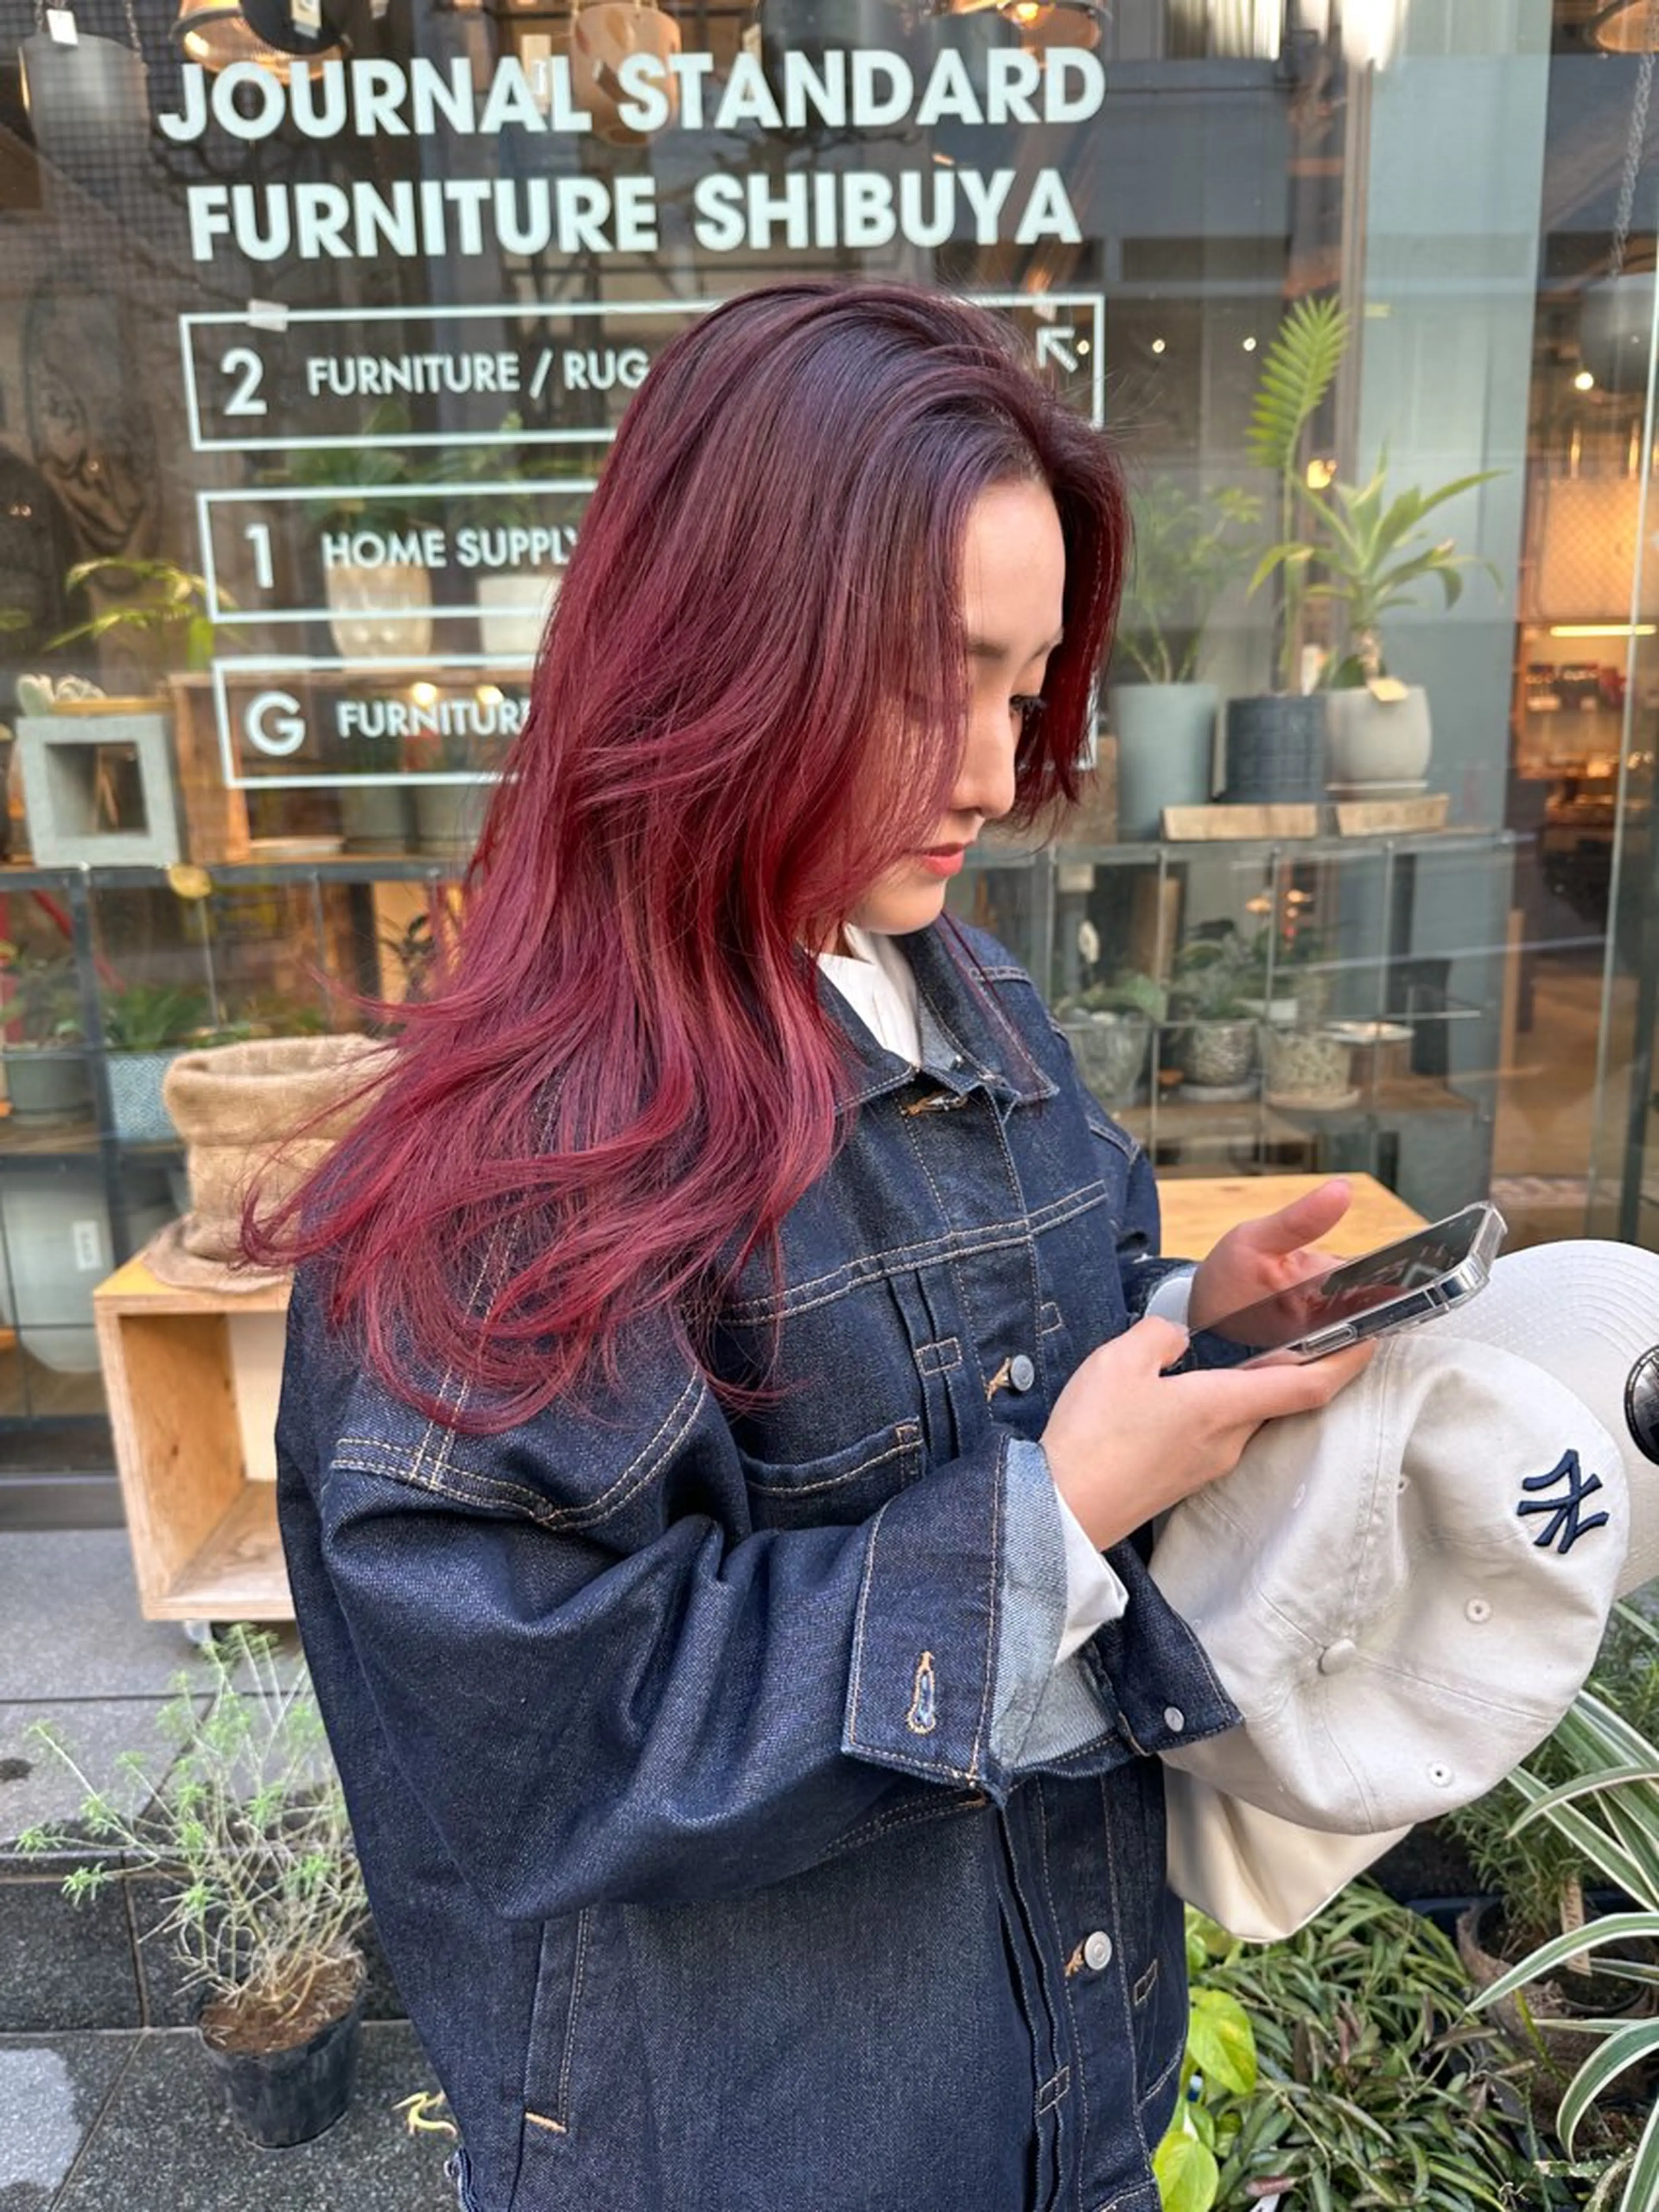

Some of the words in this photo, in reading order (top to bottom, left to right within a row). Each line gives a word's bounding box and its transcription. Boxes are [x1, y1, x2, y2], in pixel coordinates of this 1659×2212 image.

[158, 56, 592, 141] JOURNAL
[617, 46, 1106, 132] STANDARD
[187, 176, 658, 261] FURNITURE
[694, 169, 1082, 251] SHIBUYA
[221, 348, 267, 415] 2
[307, 352, 520, 396] FURNITURE
[563, 348, 651, 390] RUG
[245, 523, 273, 588] 1
[321, 531, 447, 569] HOME
[245, 691, 305, 756] G
[1517, 1449, 1610, 1554] NY
